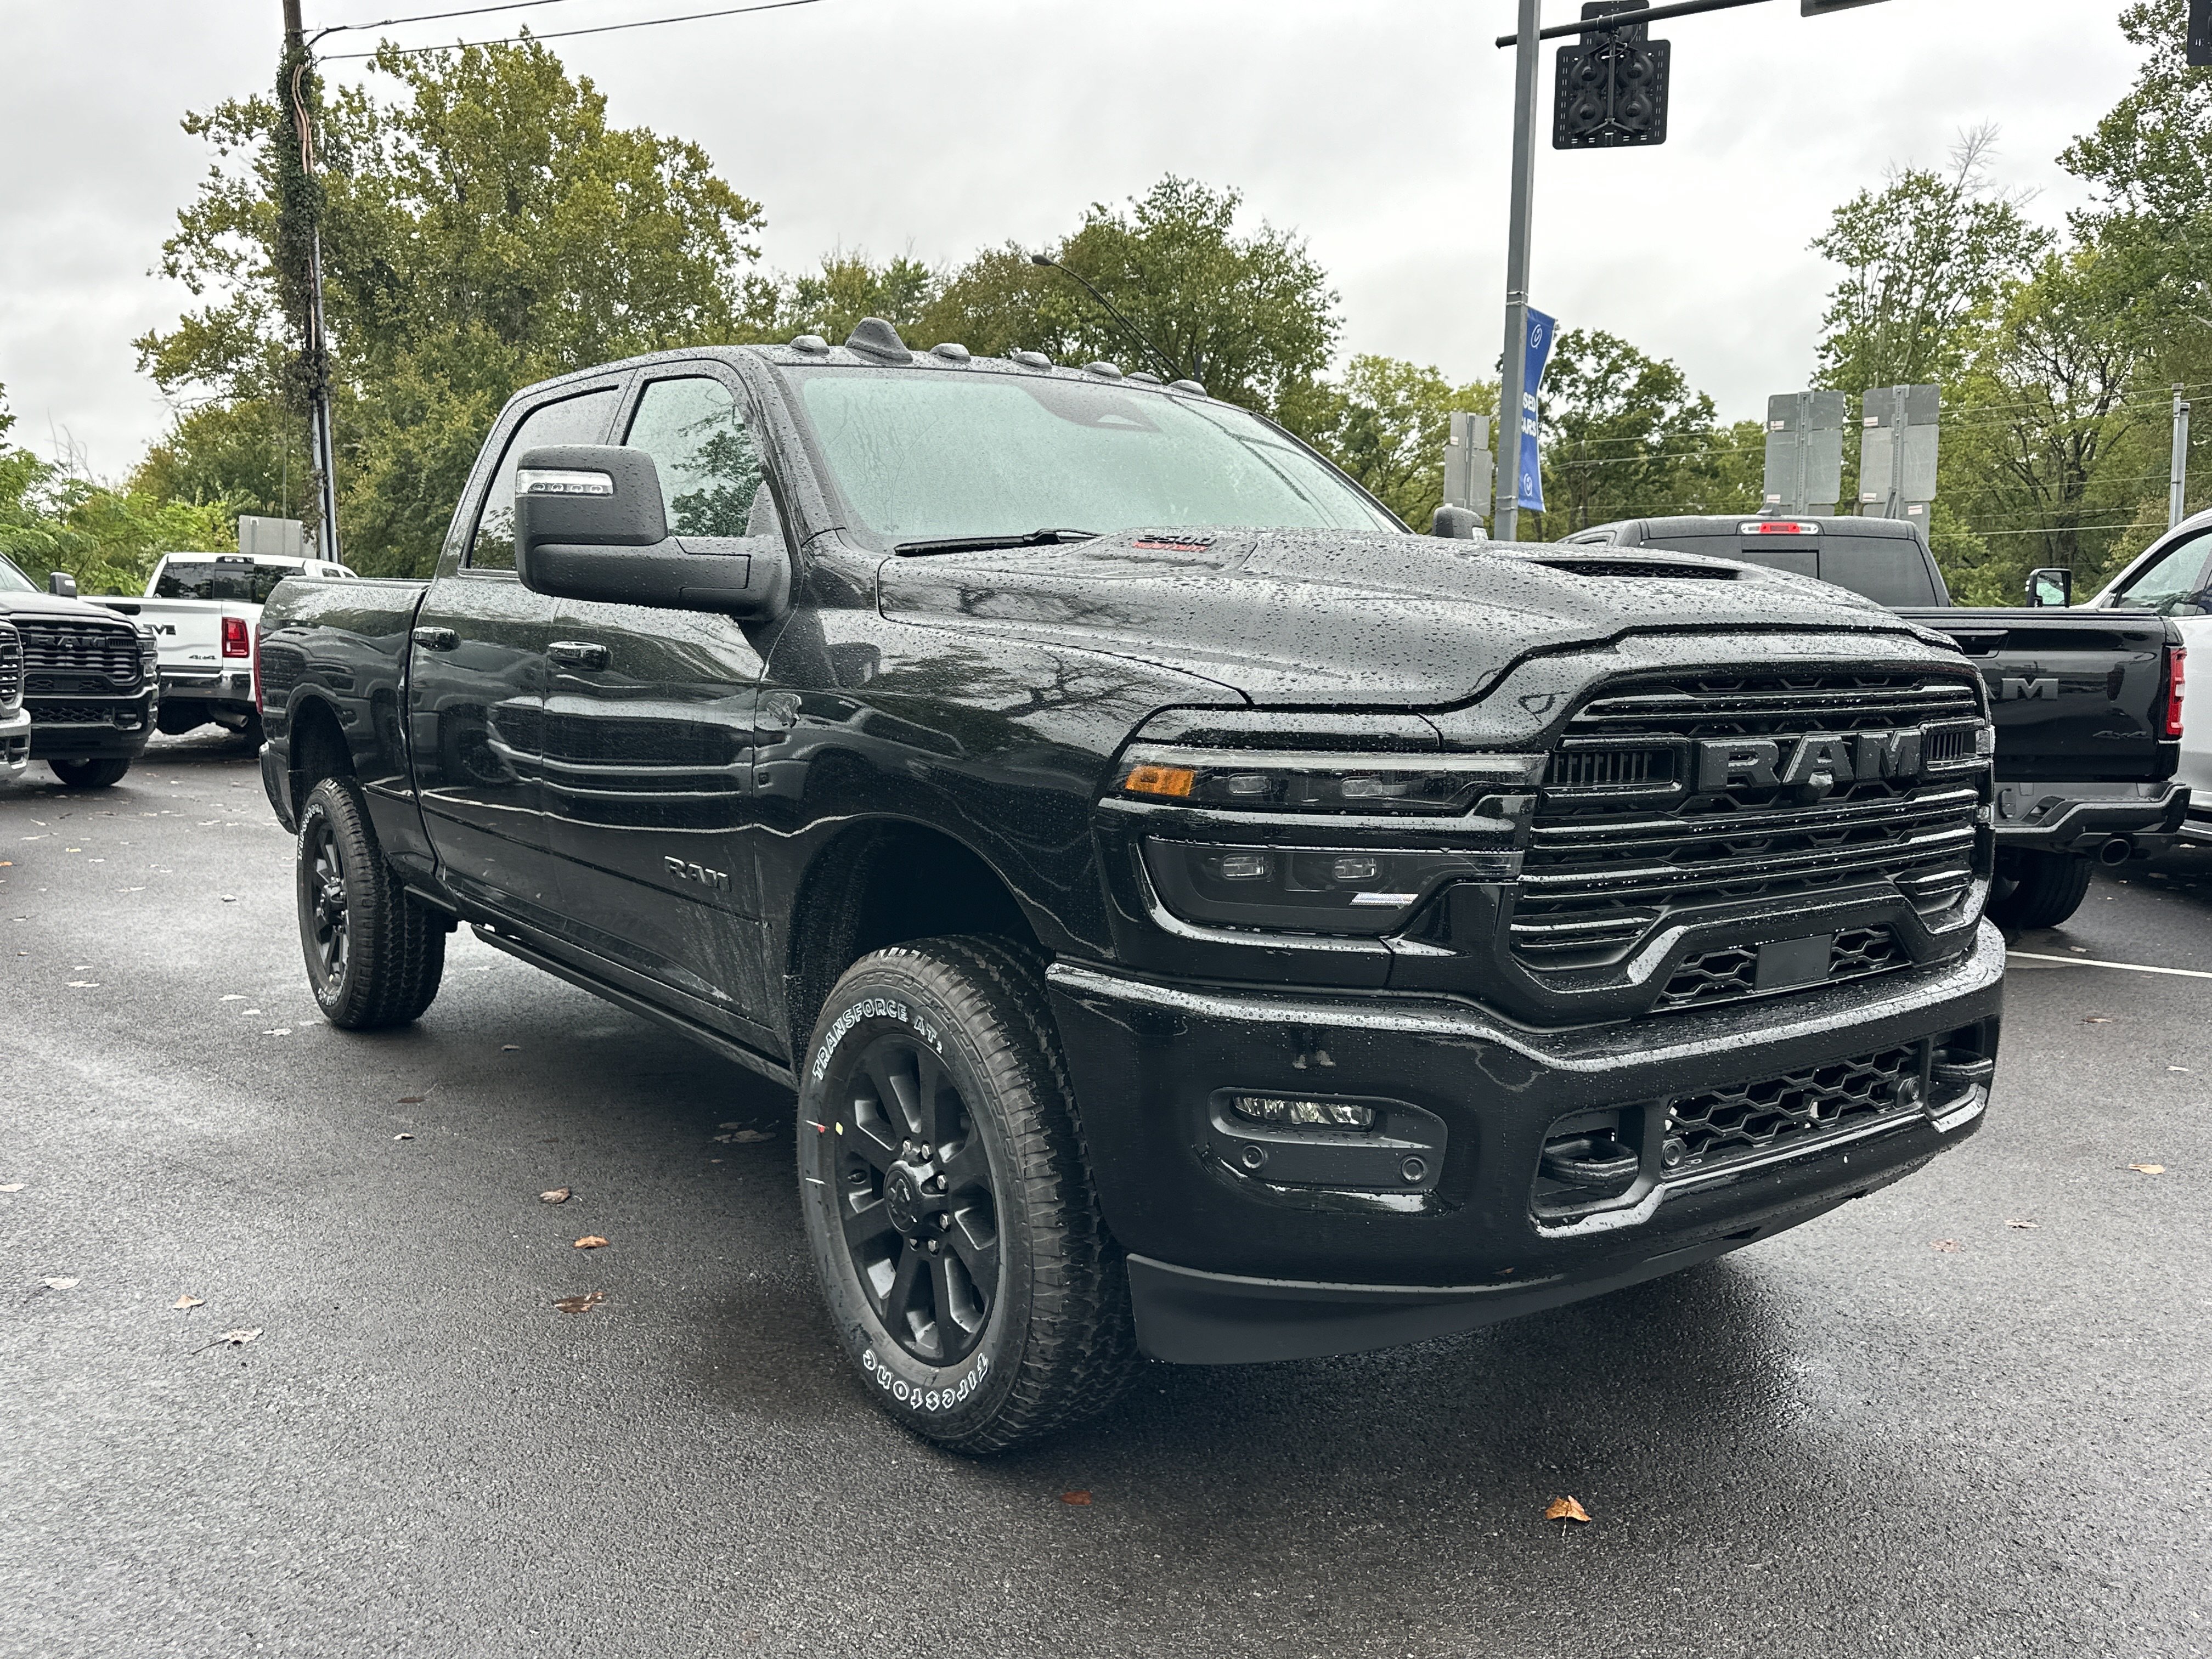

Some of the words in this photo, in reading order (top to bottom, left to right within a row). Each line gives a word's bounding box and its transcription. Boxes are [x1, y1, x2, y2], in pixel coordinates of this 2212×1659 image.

[1523, 392, 1536, 413] SED
[30, 635, 109, 648] RAM
[1699, 731, 1921, 791] RAM
[664, 855, 732, 892] RAM
[812, 998, 909, 1080] TRANSFORCE
